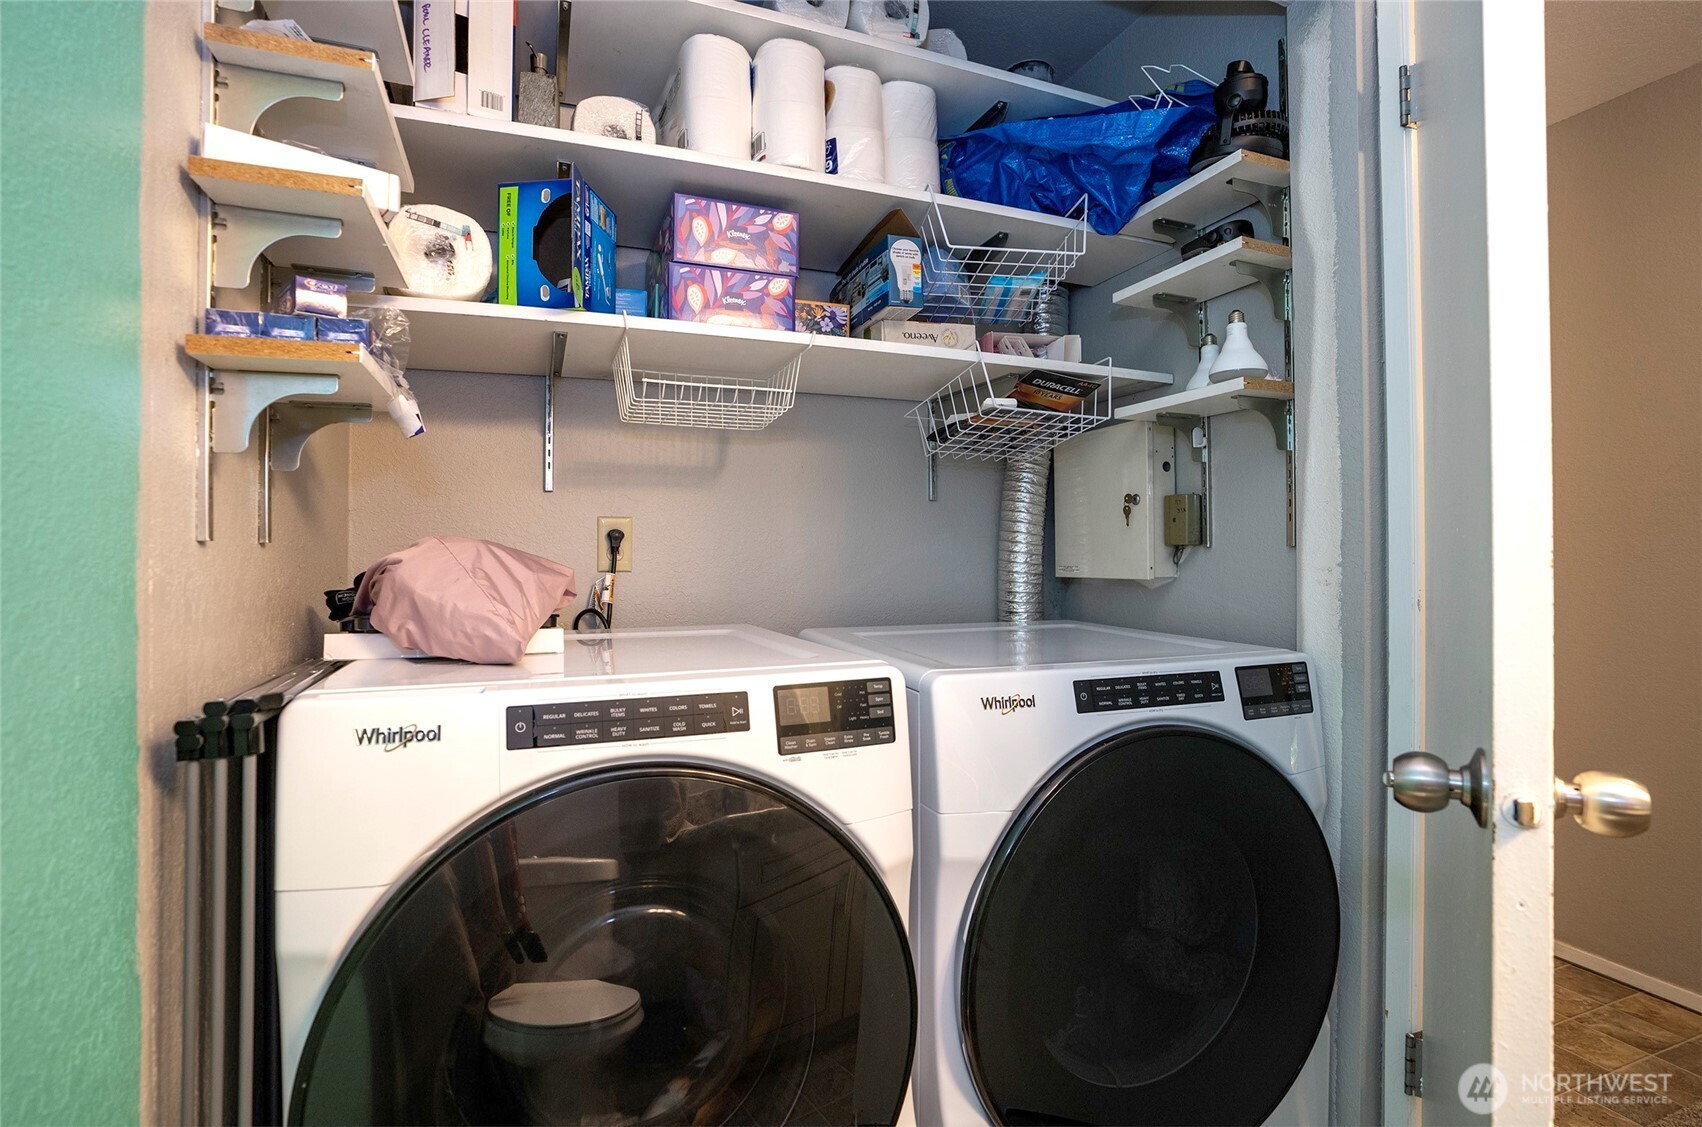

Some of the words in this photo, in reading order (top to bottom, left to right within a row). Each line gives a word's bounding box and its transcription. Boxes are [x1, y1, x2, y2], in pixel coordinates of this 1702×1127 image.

[726, 229, 751, 240] Kleenex
[721, 295, 746, 306] Kleenex
[903, 332, 938, 343] Aveeno
[1032, 378, 1080, 394] DURACELL
[980, 694, 1036, 713] Whirlpool
[354, 724, 442, 750] Whirlpool
